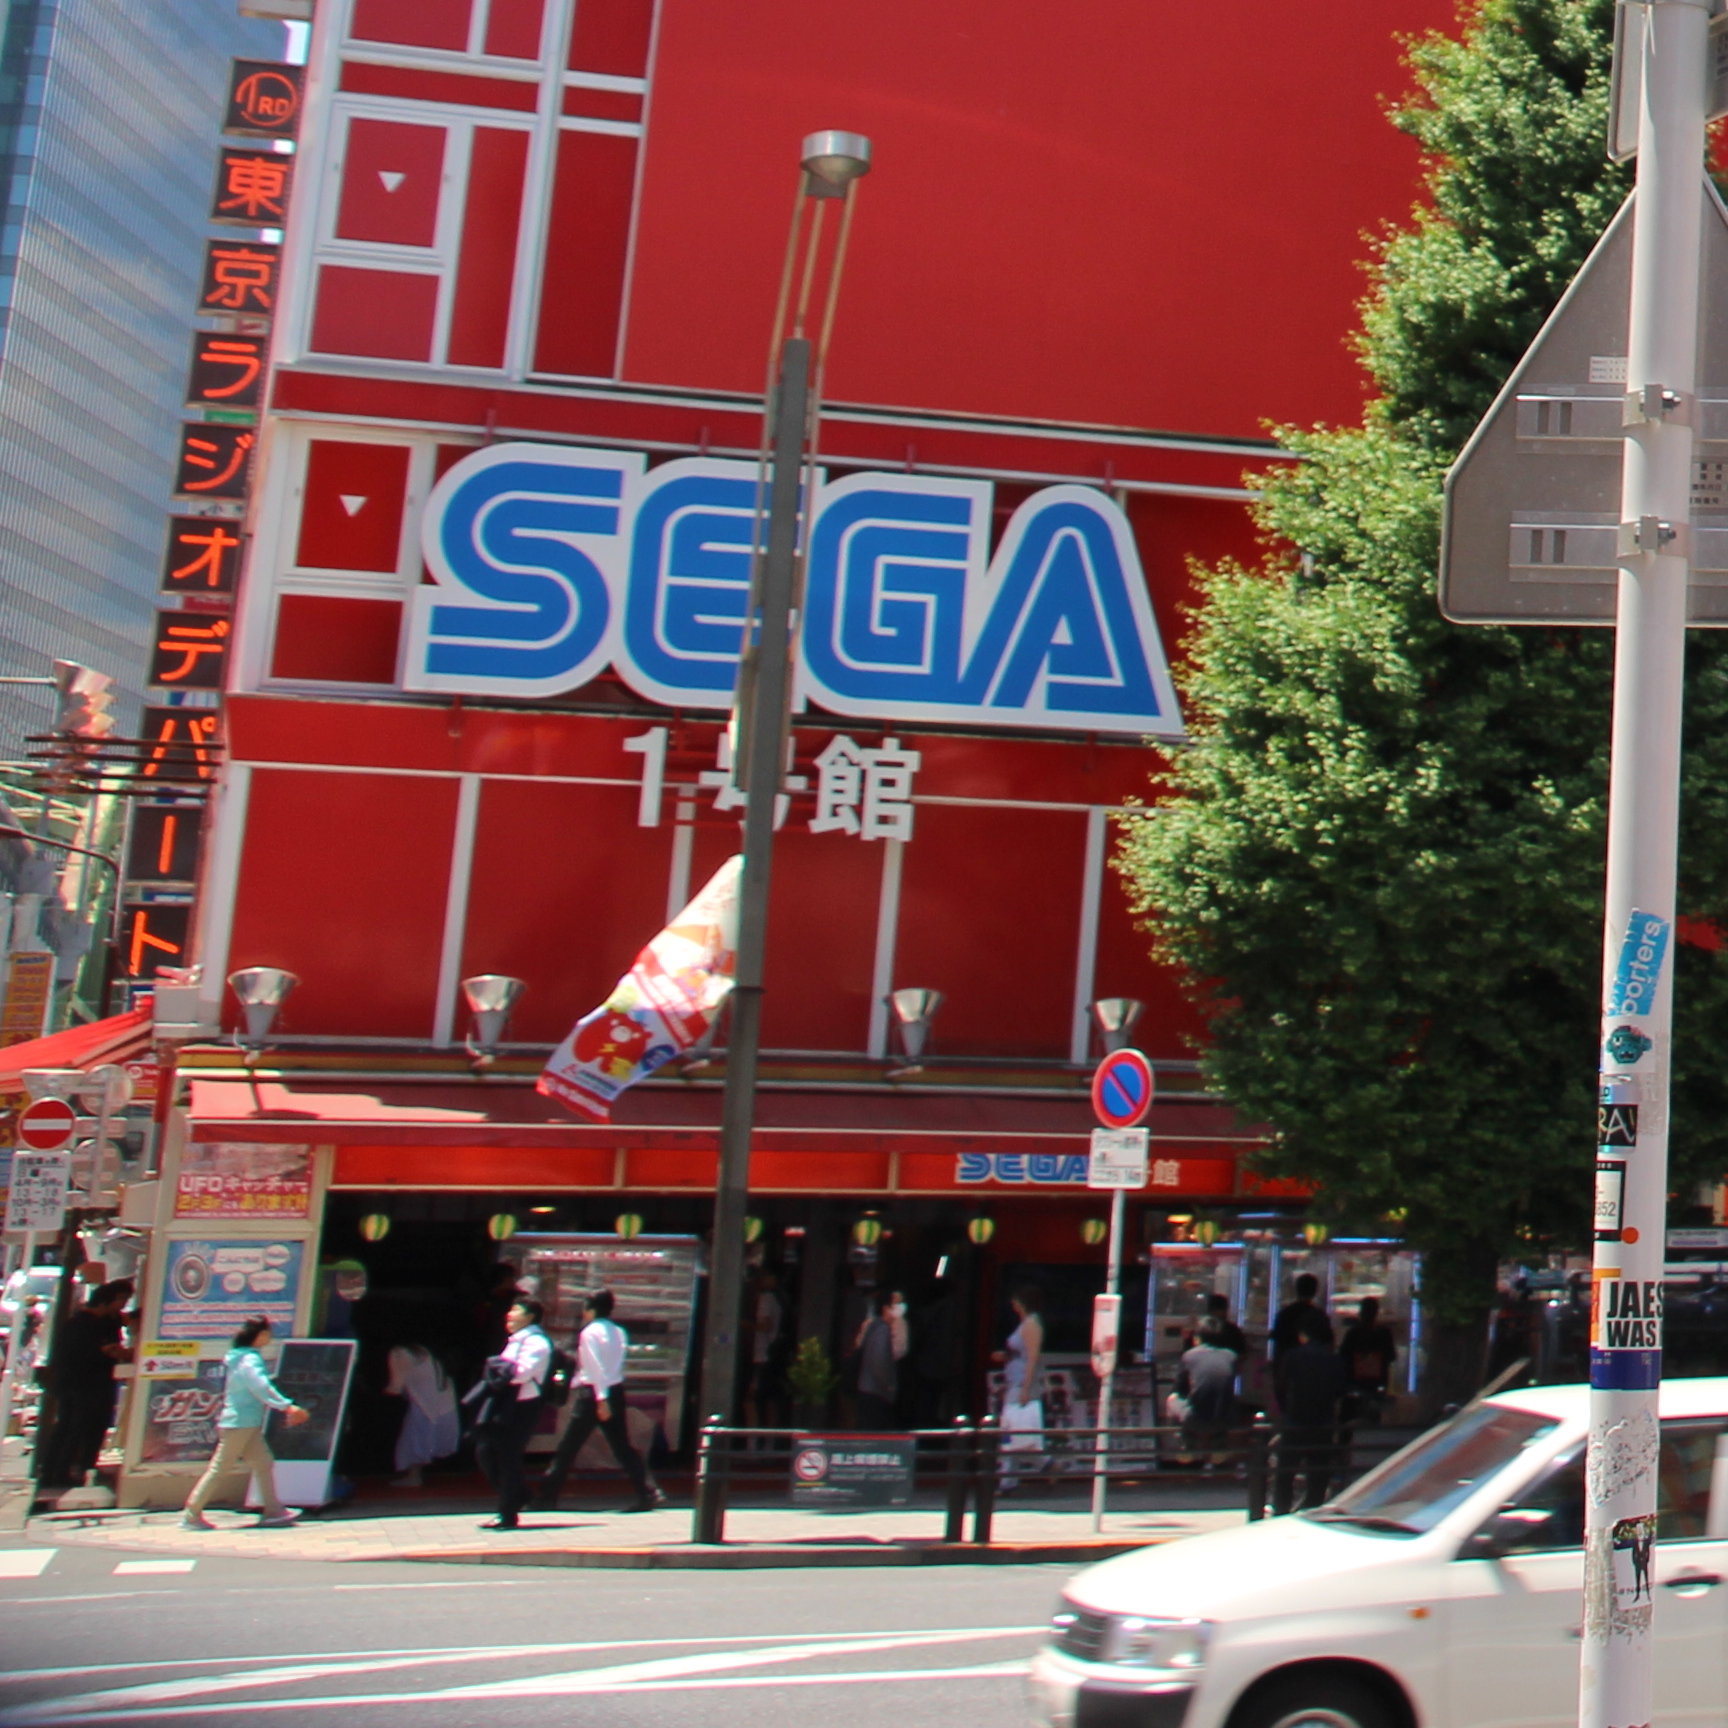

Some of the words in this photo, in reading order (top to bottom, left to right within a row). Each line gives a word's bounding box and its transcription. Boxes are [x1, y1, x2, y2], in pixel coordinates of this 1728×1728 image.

[129, 157, 290, 976] 東京ラジオデパート
[404, 441, 1188, 734] SEGA
[954, 1152, 1089, 1184] SEGA
